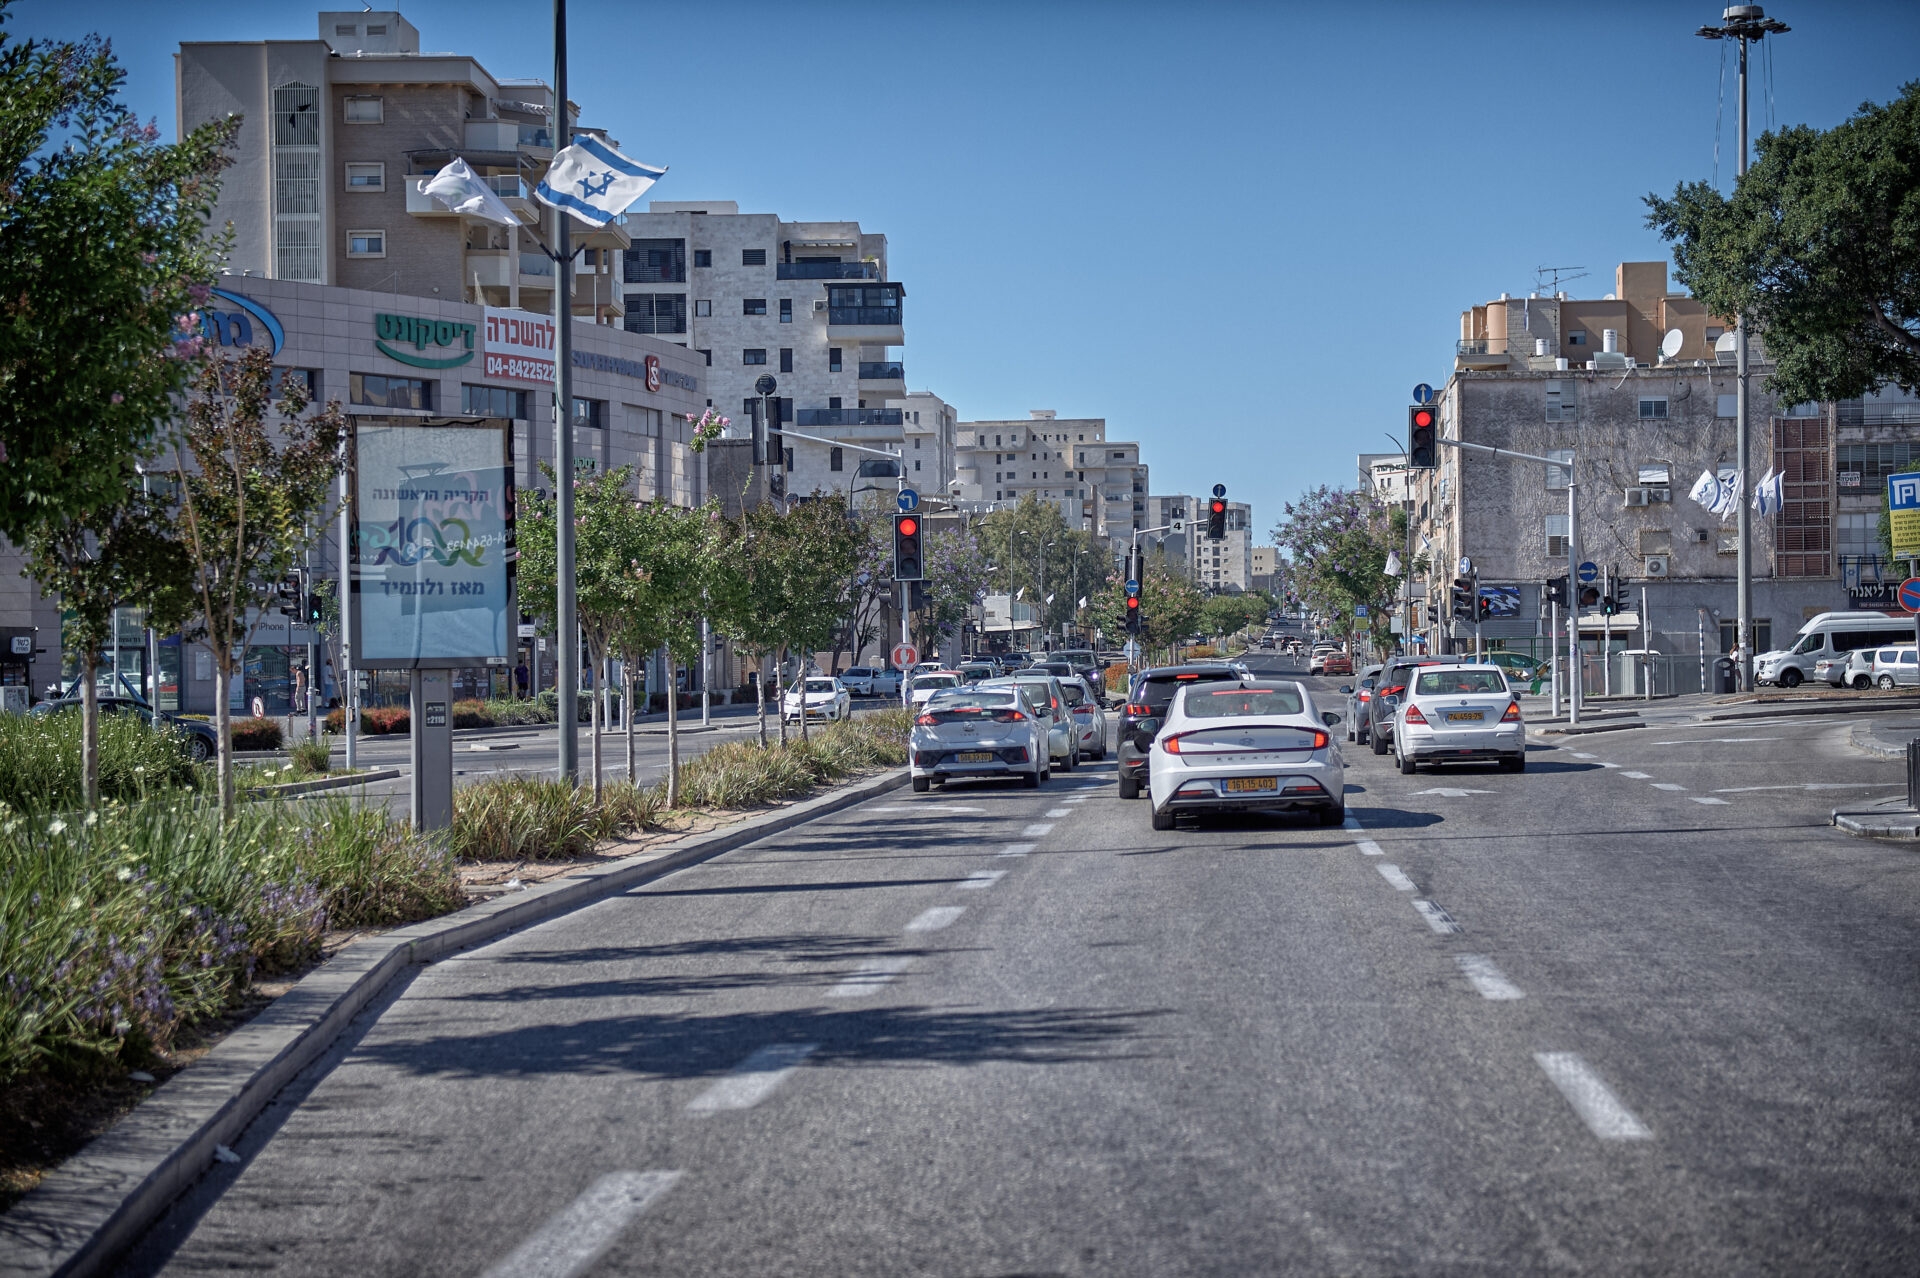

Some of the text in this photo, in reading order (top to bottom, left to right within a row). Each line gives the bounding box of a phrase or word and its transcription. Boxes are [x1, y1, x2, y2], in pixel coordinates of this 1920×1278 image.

[376, 313, 476, 350] דיסקונט
[487, 316, 556, 350] להשכרה
[487, 356, 556, 383] 04-8422522
[372, 488, 489, 504] הקריה הראשונה
[1173, 522, 1182, 531] 4
[380, 578, 485, 595] מאז ולתמיד
[1850, 582, 1885, 598] ליאנה
[259, 622, 284, 631] iPhone
